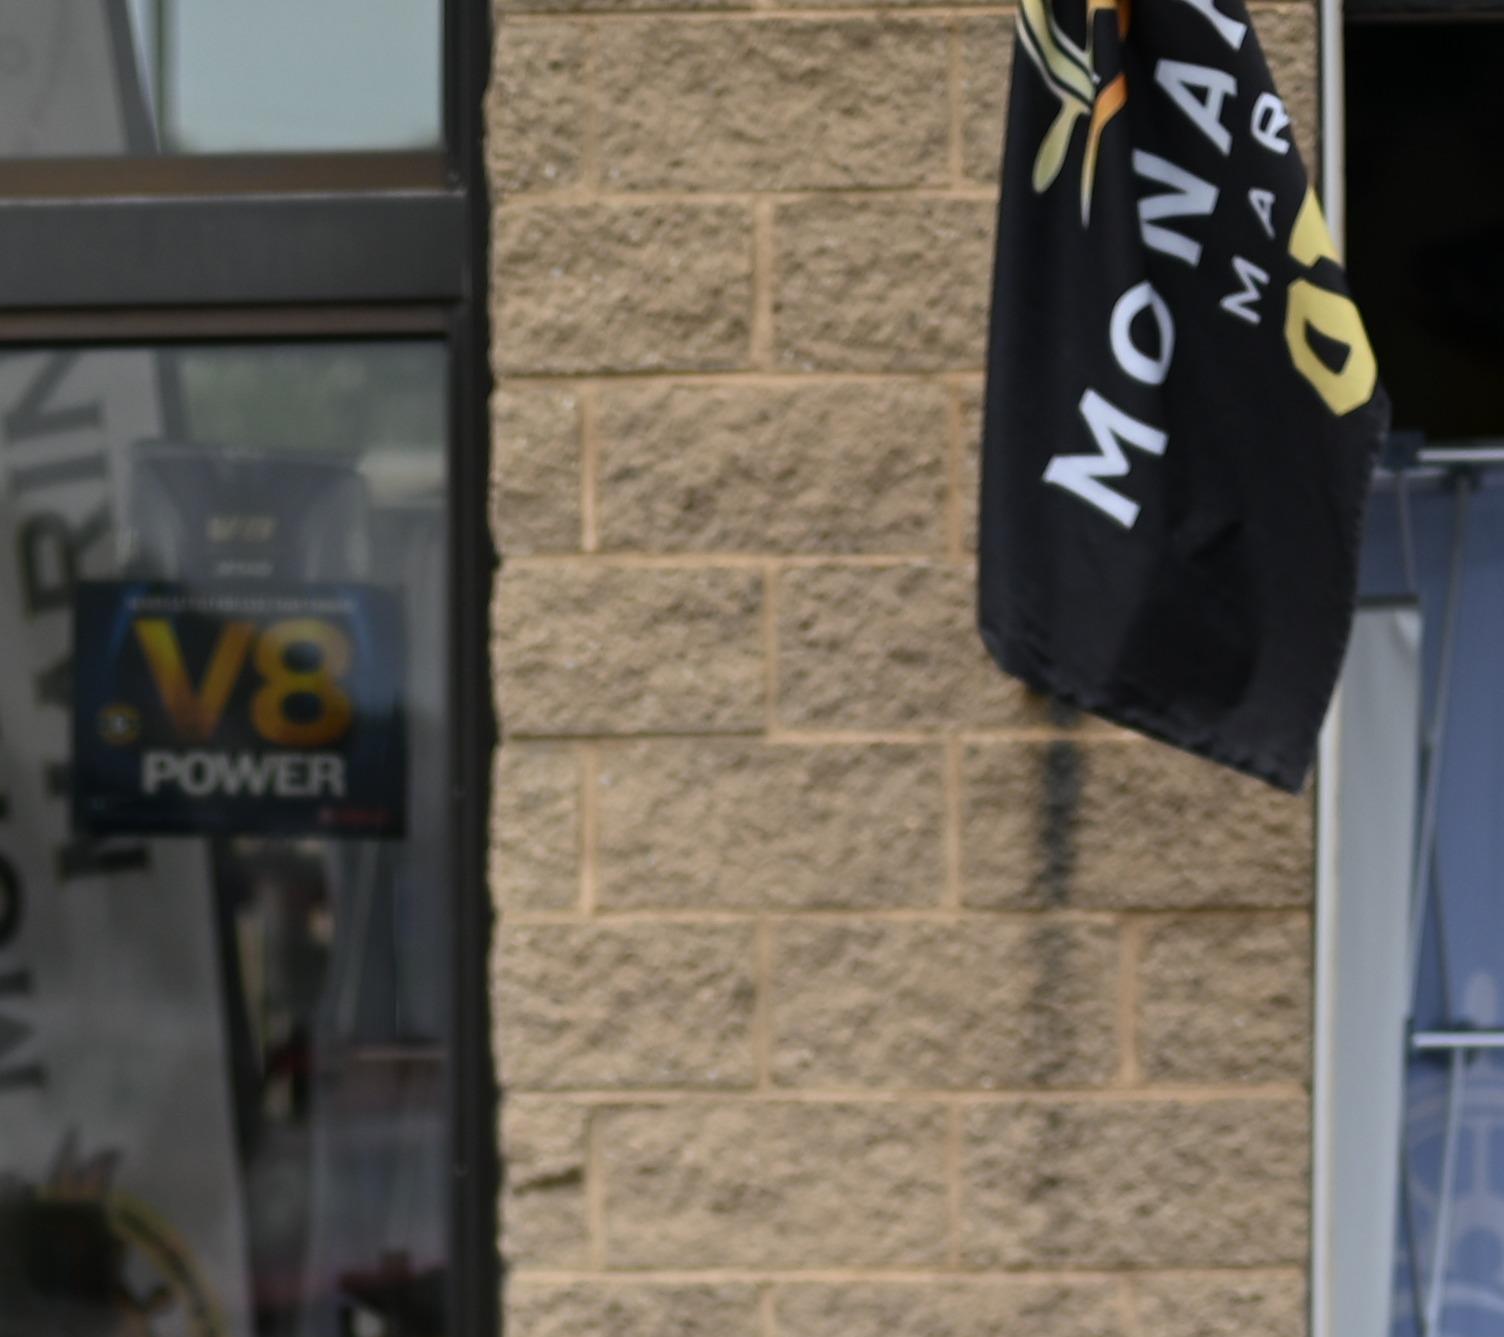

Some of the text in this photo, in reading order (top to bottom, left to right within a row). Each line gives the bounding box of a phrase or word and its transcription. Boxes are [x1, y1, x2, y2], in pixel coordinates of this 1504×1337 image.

[1042, 0, 1248, 530] MONA
[134, 618, 353, 747] V8
[142, 751, 346, 799] POWER
